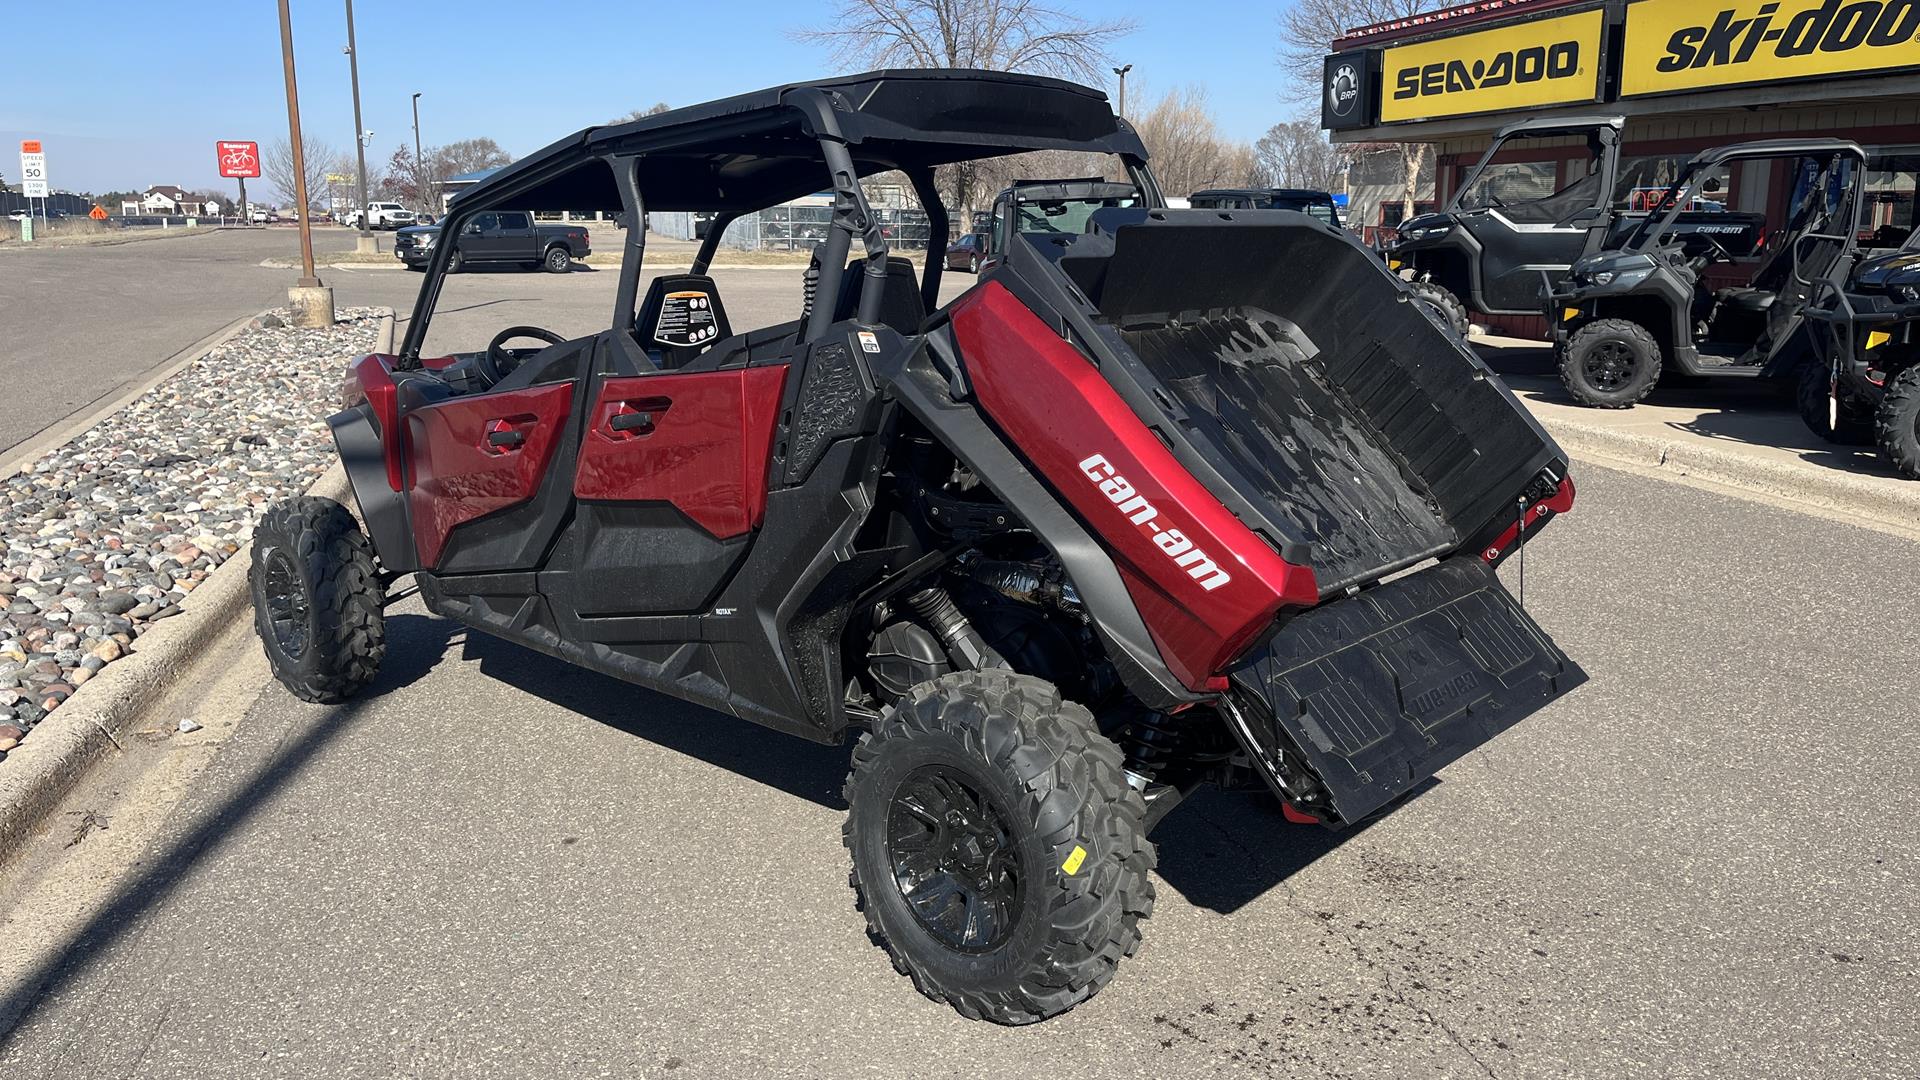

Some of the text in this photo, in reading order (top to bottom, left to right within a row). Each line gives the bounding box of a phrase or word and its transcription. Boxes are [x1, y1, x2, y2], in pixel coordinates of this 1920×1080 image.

[1340, 90, 1356, 100] BRP
[26, 168, 41, 177] 50
[1695, 226, 1743, 234] can-am
[1079, 453, 1231, 591] can-am
